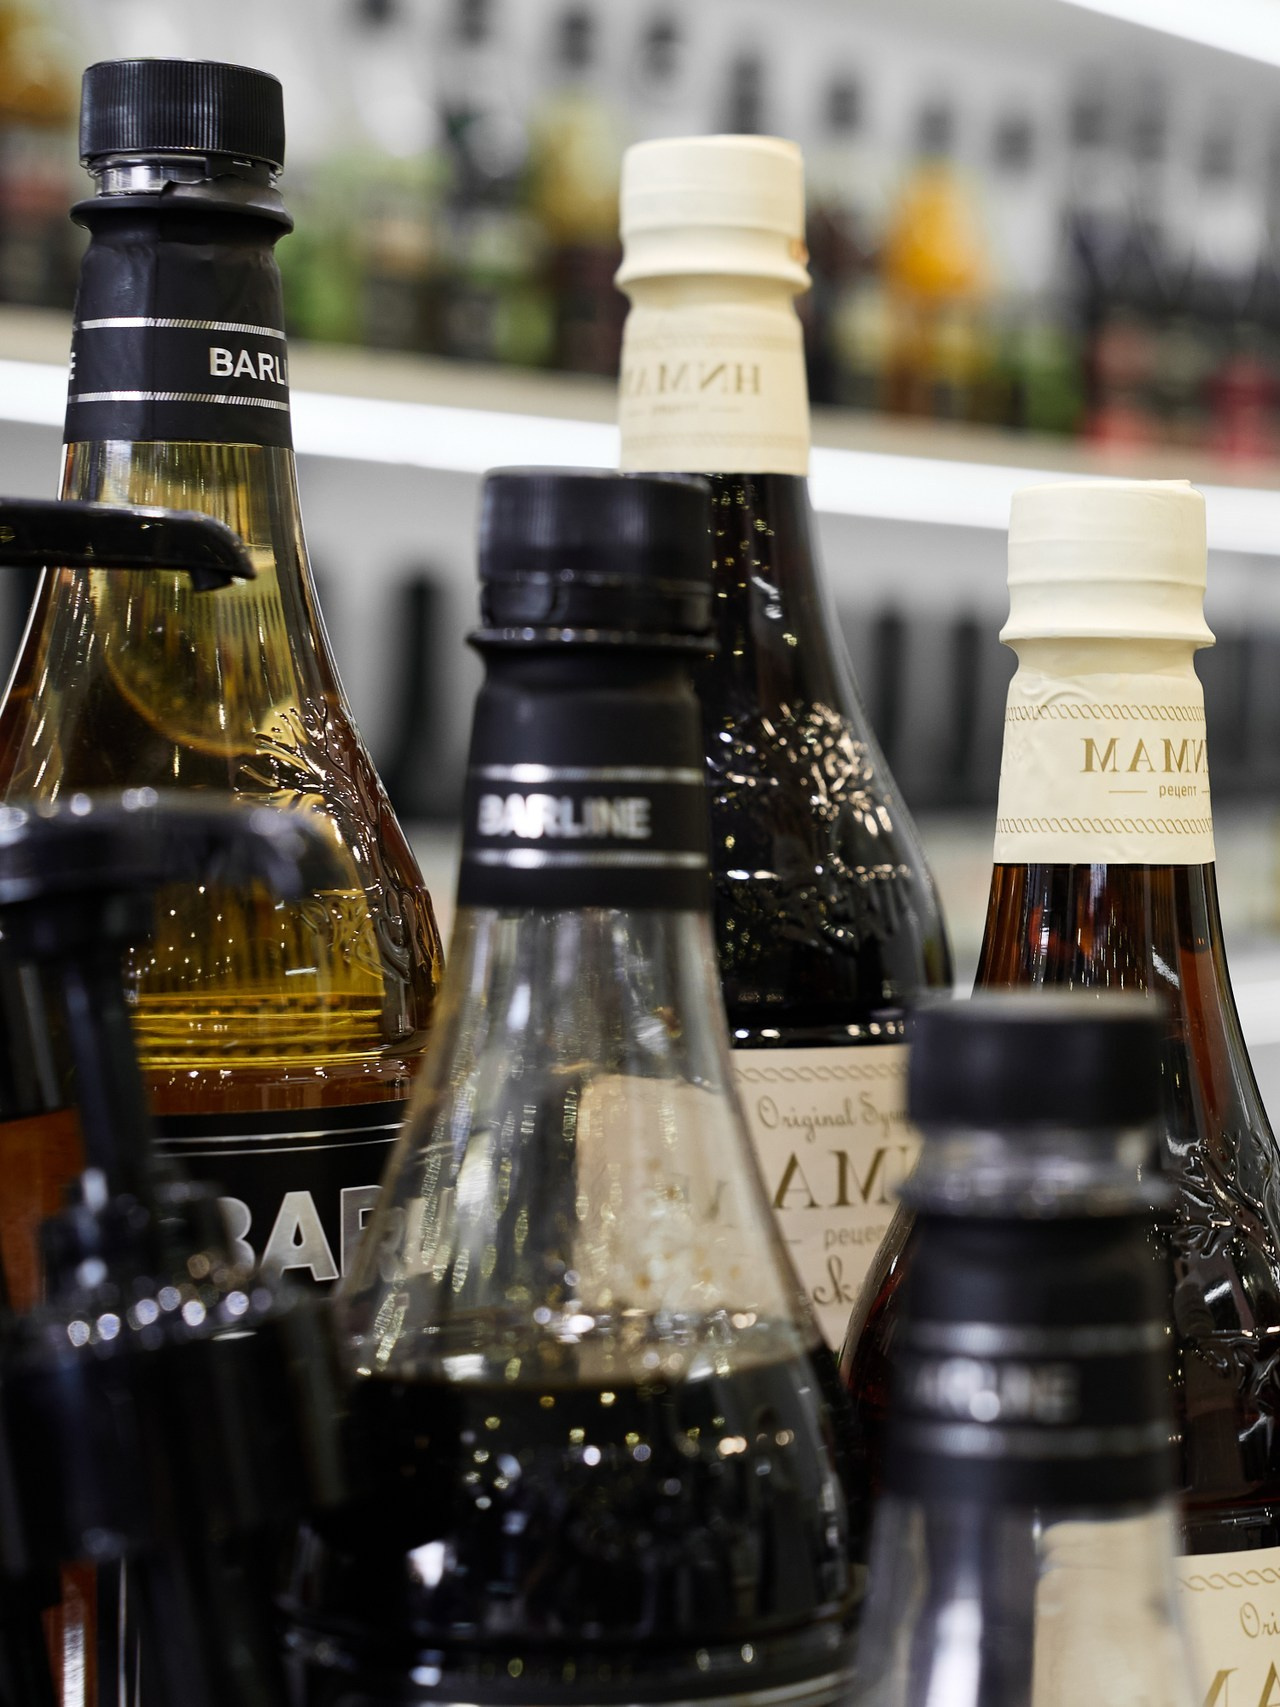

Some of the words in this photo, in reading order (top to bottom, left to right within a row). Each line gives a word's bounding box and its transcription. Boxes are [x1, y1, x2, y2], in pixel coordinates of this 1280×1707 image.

[1080, 738, 1209, 774] МАМИ
[1159, 784, 1197, 799] рецепт
[477, 793, 652, 839] BARLINE
[757, 1095, 855, 1143] Original
